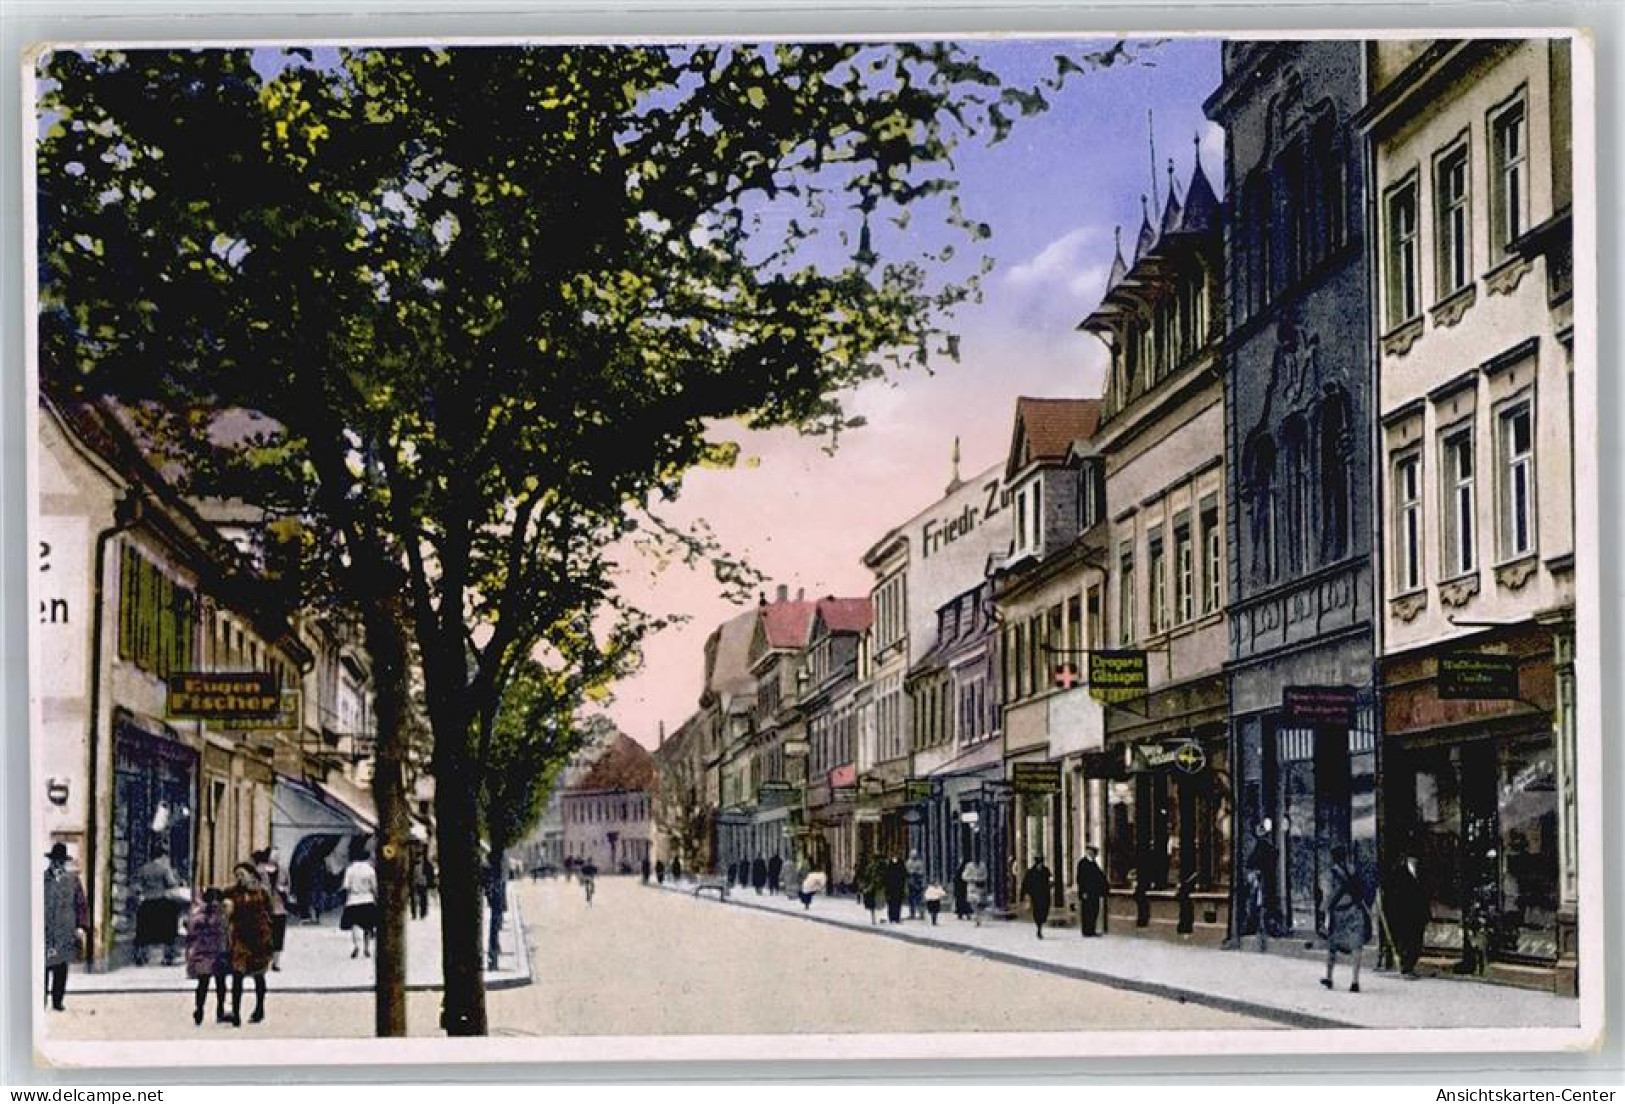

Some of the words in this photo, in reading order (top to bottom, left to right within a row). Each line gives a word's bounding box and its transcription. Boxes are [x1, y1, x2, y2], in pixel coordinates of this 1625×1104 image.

[922, 503, 983, 558] Friedr.
[184, 678, 262, 693] Eugen
[171, 692, 277, 710] Fischer
